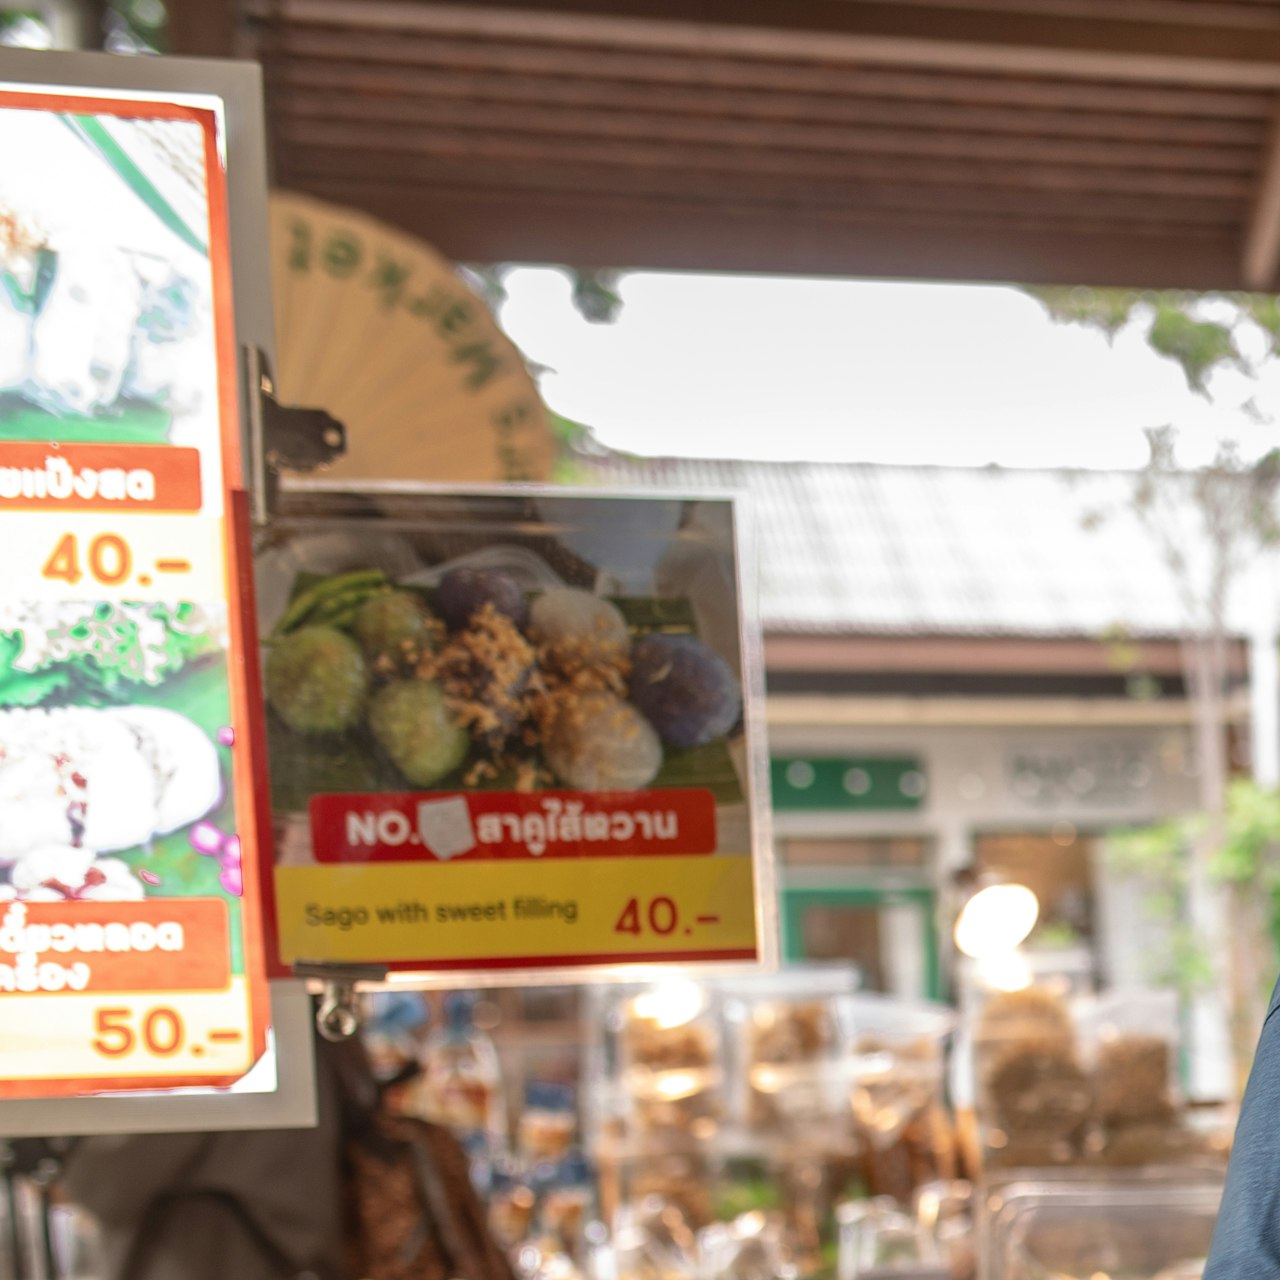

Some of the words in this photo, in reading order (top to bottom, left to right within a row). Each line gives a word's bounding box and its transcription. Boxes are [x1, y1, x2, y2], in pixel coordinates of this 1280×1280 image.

[42, 532, 192, 586] 40.-
[346, 809, 422, 846] NO.
[477, 797, 678, 856] สาคูไส้หวาน
[305, 903, 369, 931] Sago
[376, 900, 429, 924] with
[436, 900, 506, 923] sweet
[513, 895, 578, 925] filling
[614, 896, 721, 936] 40.-
[91, 1006, 243, 1059] 50.-
